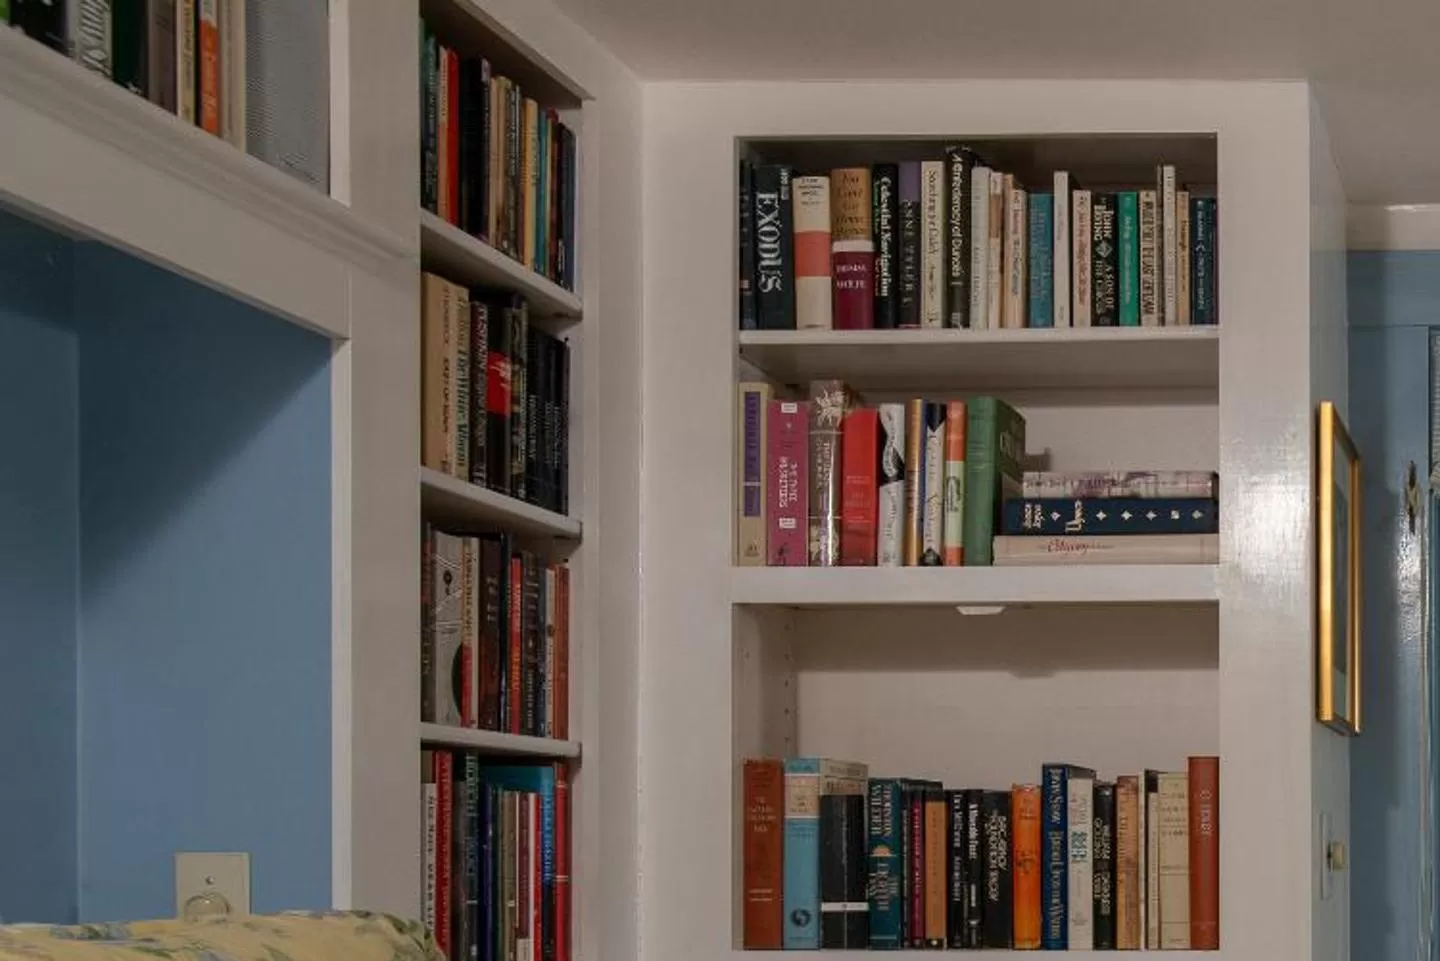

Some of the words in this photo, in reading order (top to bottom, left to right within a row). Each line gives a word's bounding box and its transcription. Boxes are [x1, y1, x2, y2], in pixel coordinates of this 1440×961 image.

[880, 177, 893, 231] Celestial
[949, 163, 963, 226] Confederacy
[756, 191, 783, 293] EXODUS
[880, 232, 893, 297] Navigation
[951, 239, 963, 277] Dunces
